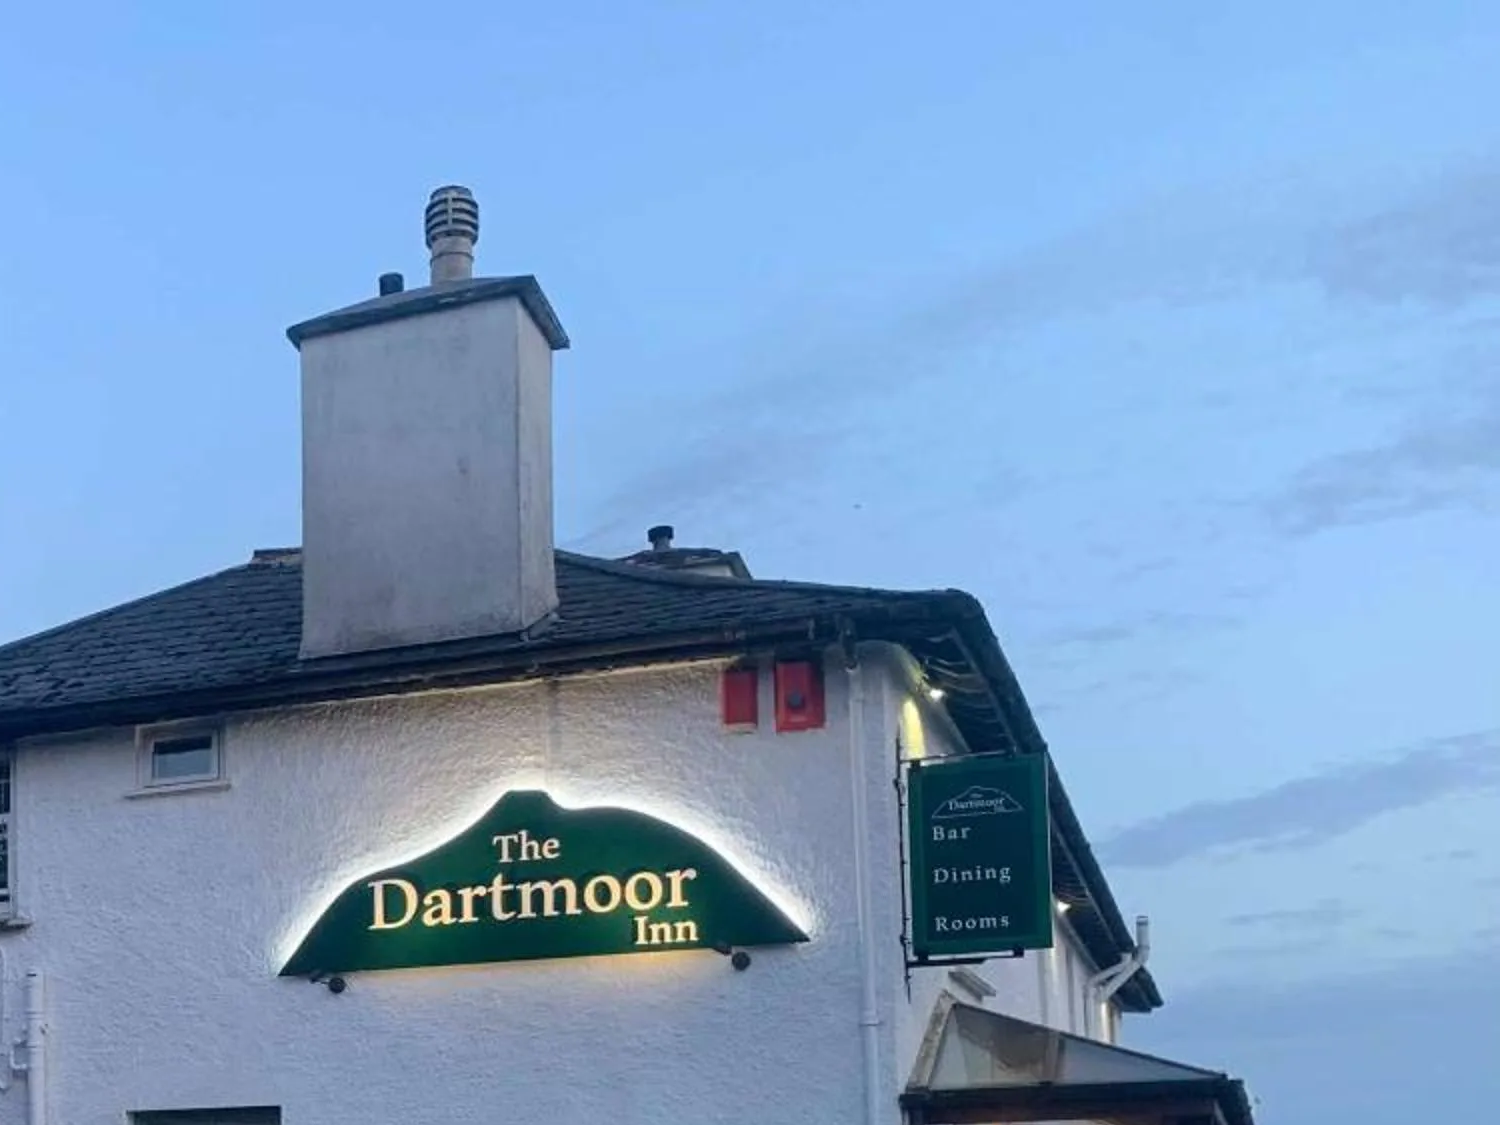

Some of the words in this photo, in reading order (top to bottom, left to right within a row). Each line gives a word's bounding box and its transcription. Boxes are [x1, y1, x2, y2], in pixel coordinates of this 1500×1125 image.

[932, 826, 971, 841] Bar
[493, 830, 561, 863] The
[933, 865, 1011, 884] Dining
[367, 867, 697, 930] Dartmoor
[634, 916, 699, 944] Inn
[935, 915, 1010, 932] Rooms
